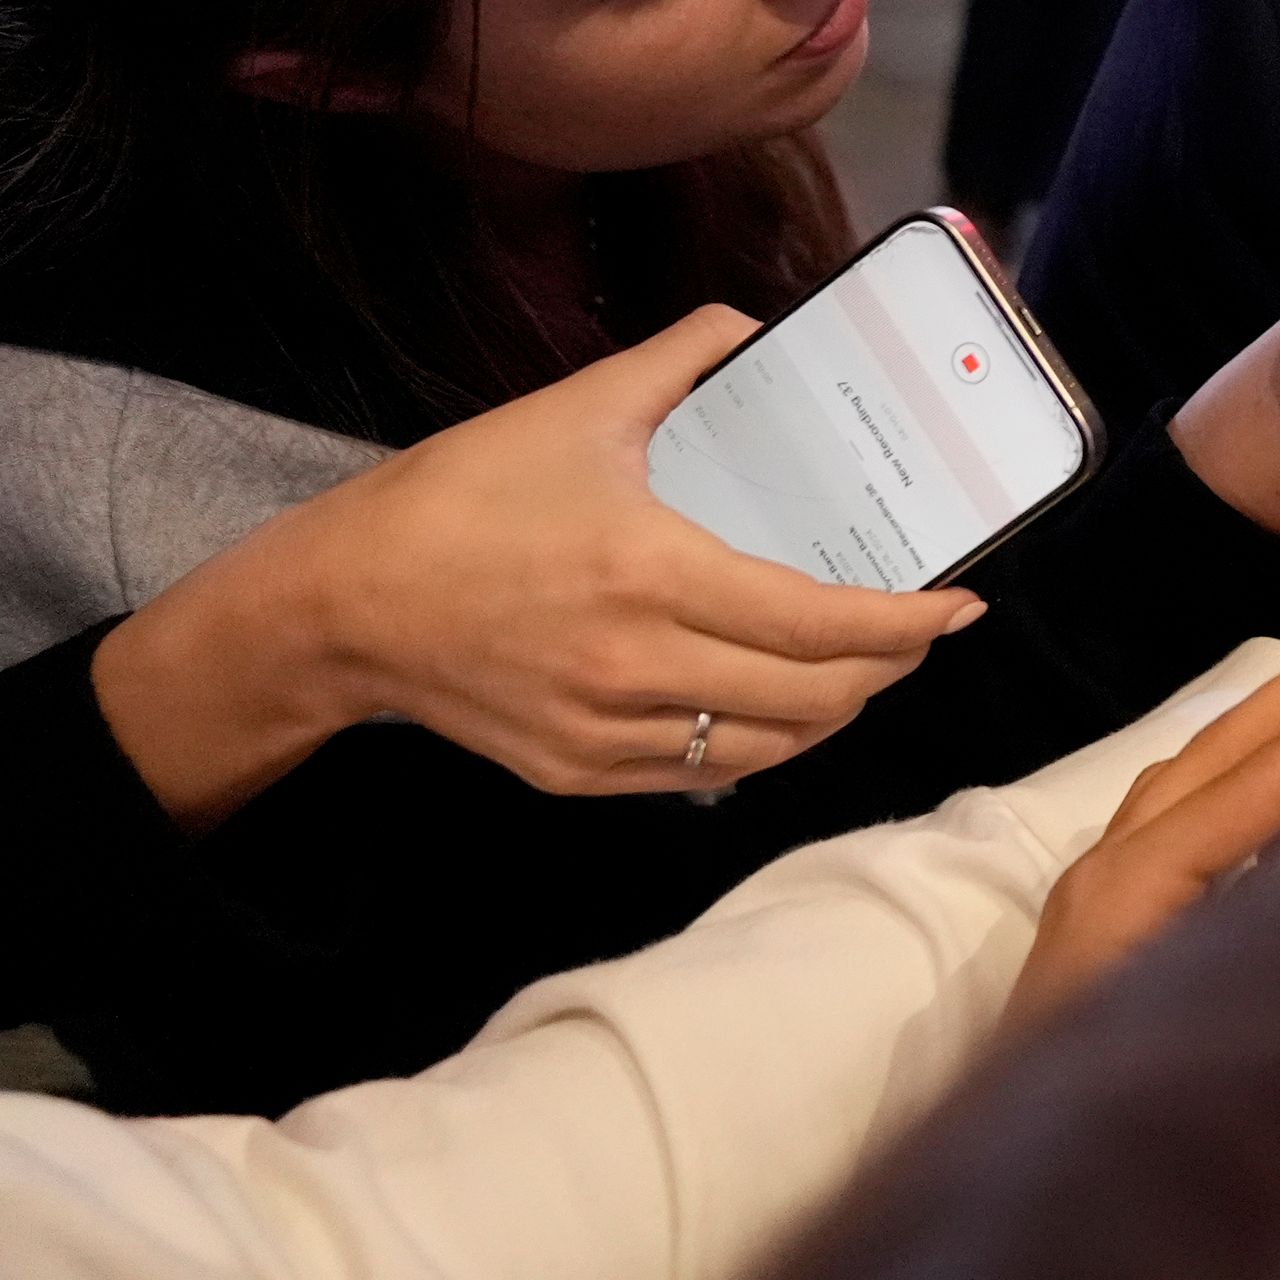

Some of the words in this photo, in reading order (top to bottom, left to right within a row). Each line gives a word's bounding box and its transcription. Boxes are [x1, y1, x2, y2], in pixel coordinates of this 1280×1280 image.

[837, 380, 854, 397] 37
[851, 395, 894, 459] Recording
[891, 458, 914, 488] New
